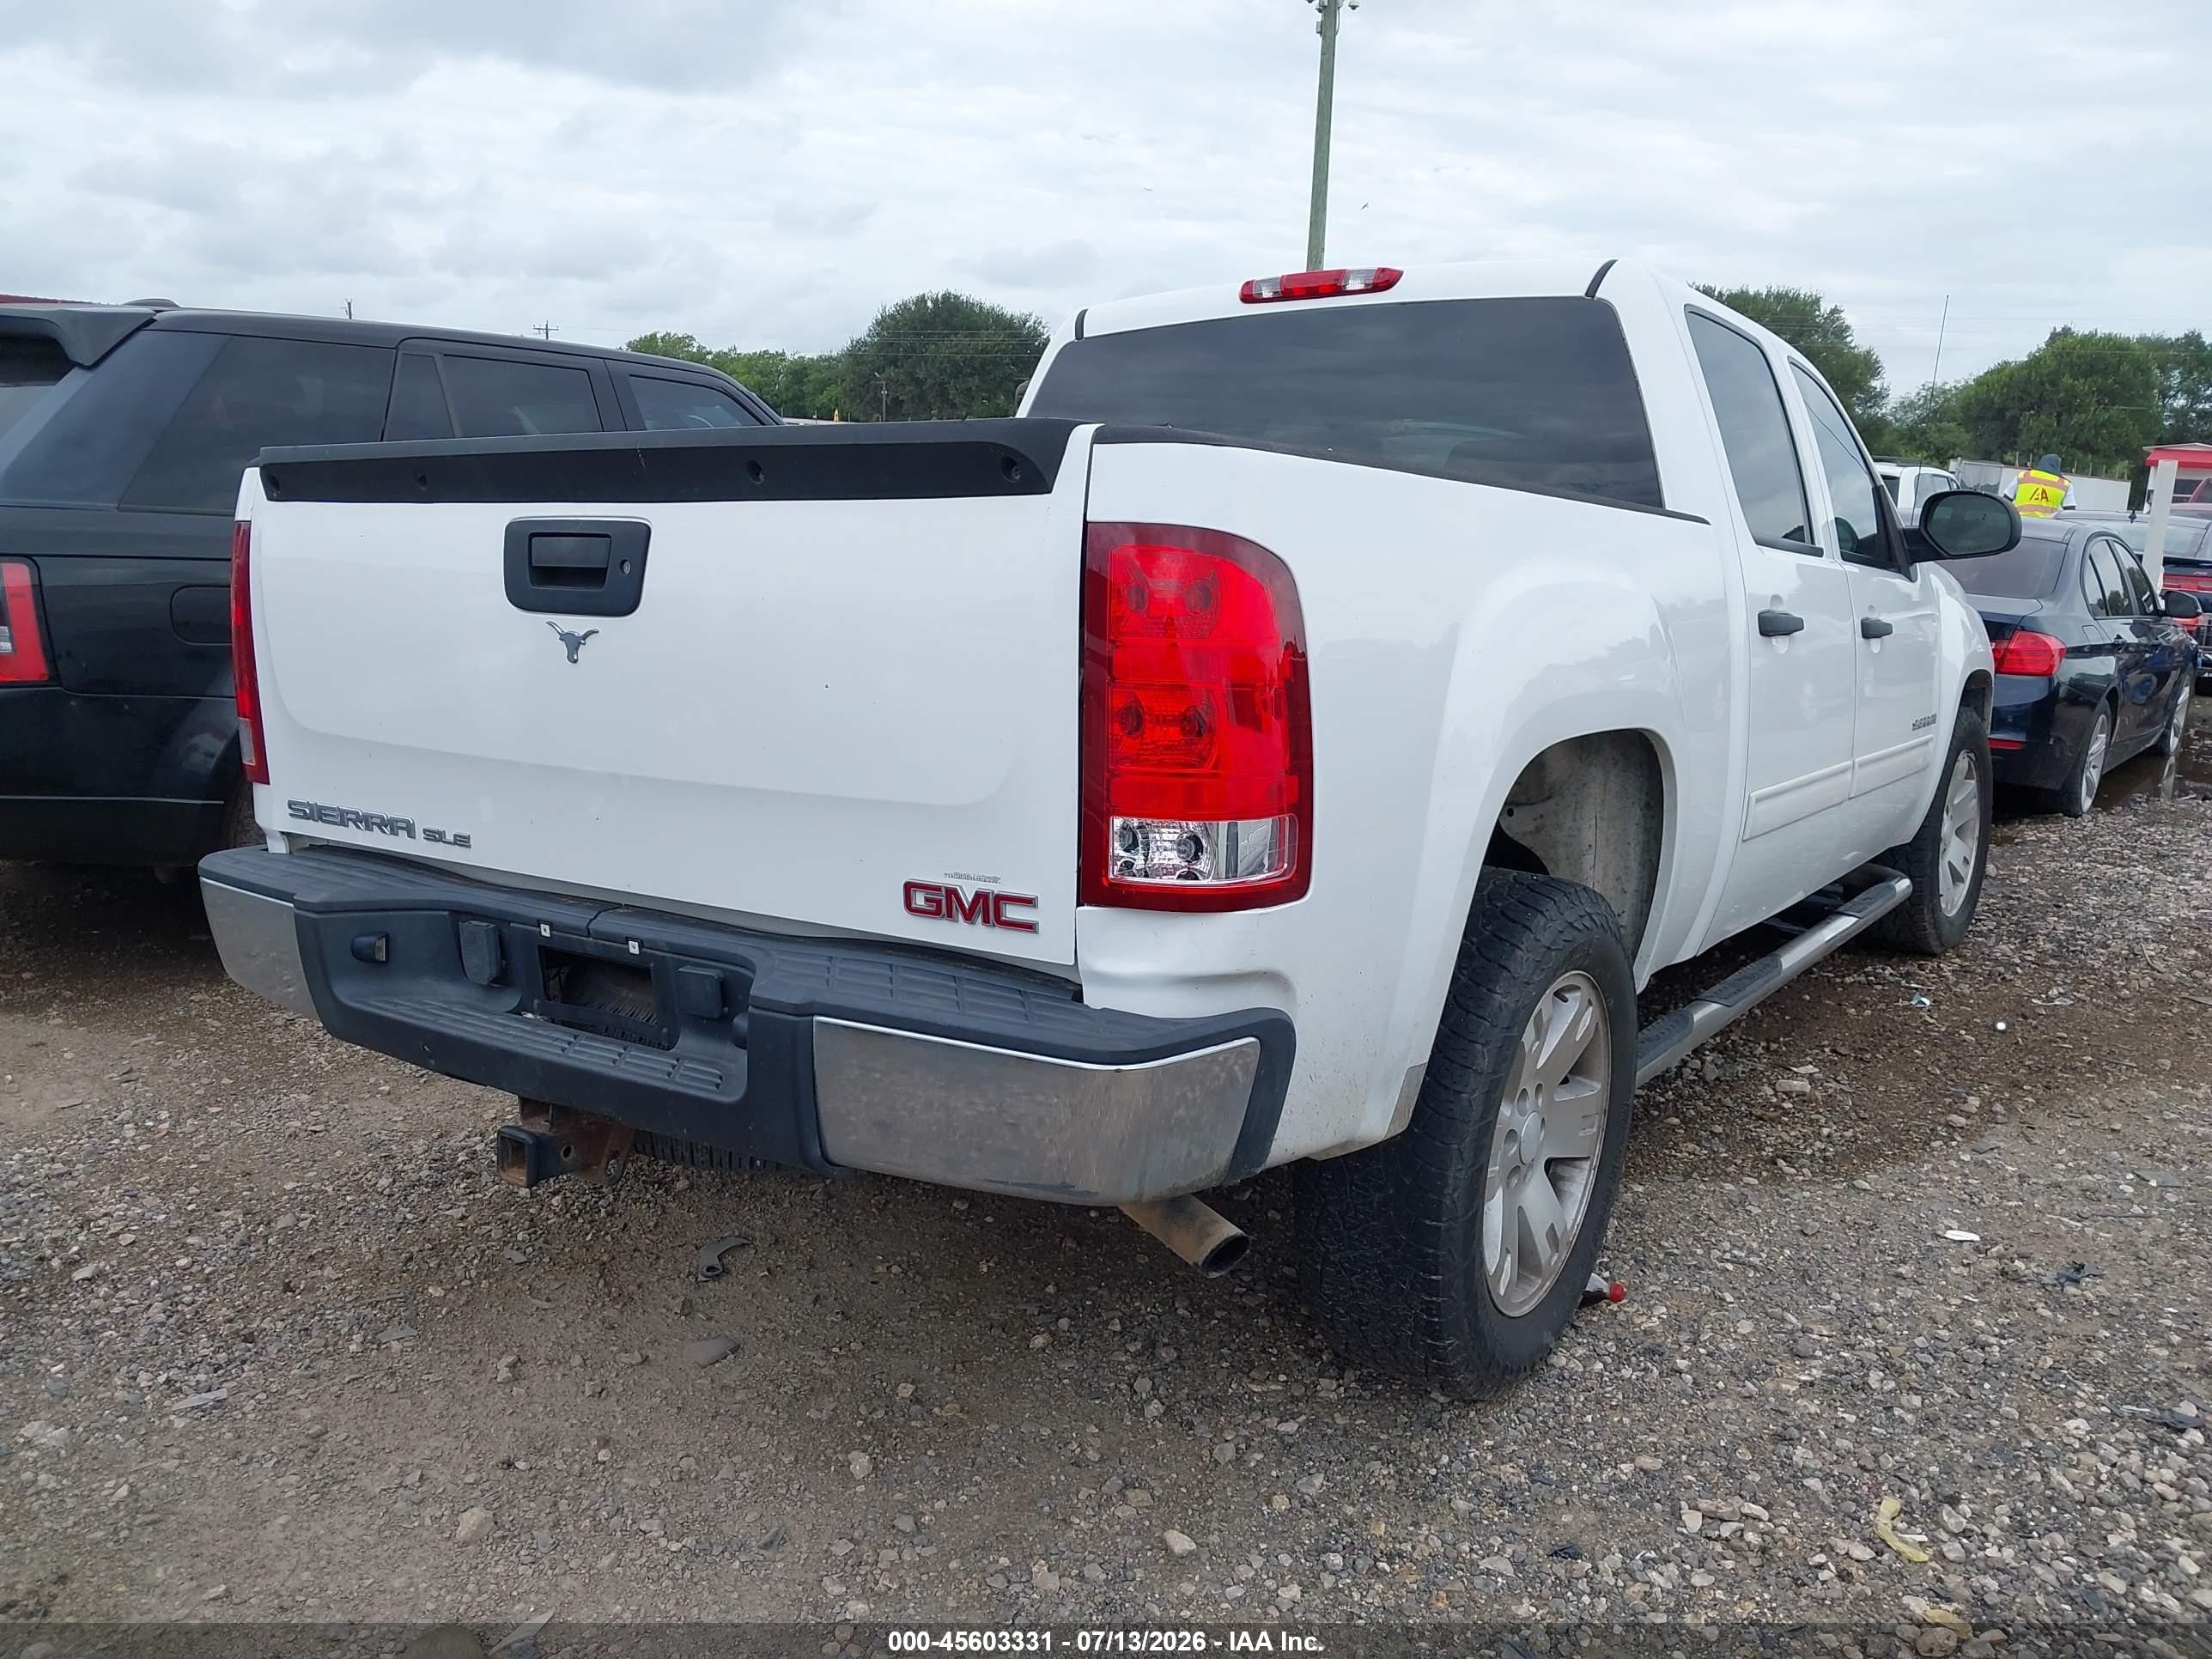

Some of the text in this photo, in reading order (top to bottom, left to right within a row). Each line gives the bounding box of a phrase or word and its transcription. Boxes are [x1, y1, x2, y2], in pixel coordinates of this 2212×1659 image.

[287, 798, 471, 849] SIERRA SLE
[902, 878, 1040, 934] GMC
